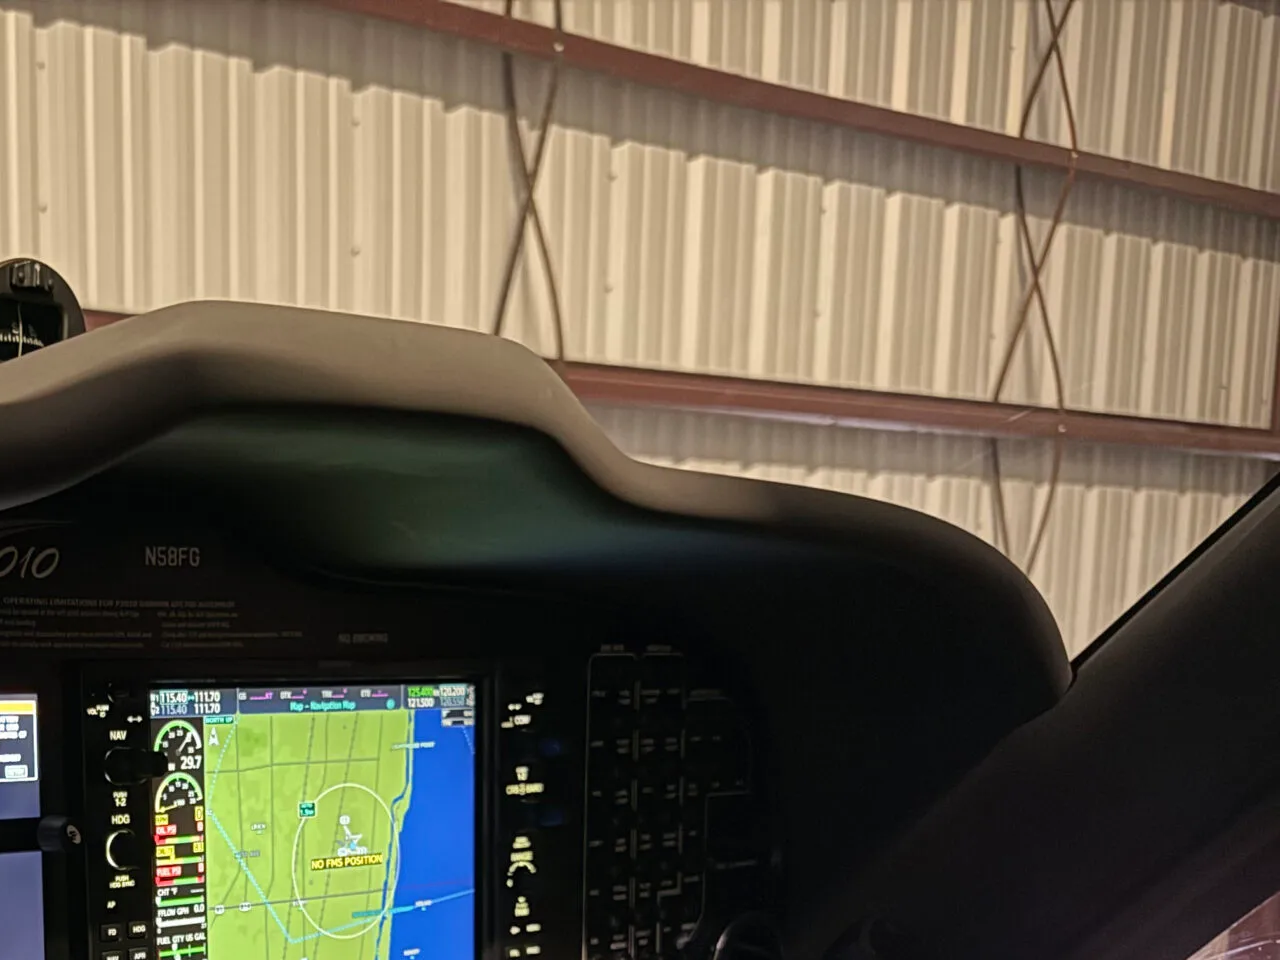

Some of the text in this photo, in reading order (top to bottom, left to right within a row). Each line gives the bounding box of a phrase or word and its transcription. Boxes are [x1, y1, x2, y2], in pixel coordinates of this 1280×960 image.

[144, 545, 200, 568] N58FG
[160, 691, 220, 703] 115.40 111.70
[162, 703, 221, 715] 115.40 111.70
[110, 730, 127, 740] NAV
[180, 755, 202, 770] 29.7
[111, 814, 130, 824] HDG
[311, 854, 383, 870] NO FMS POSITION
[108, 925, 146, 936] FD HDG
